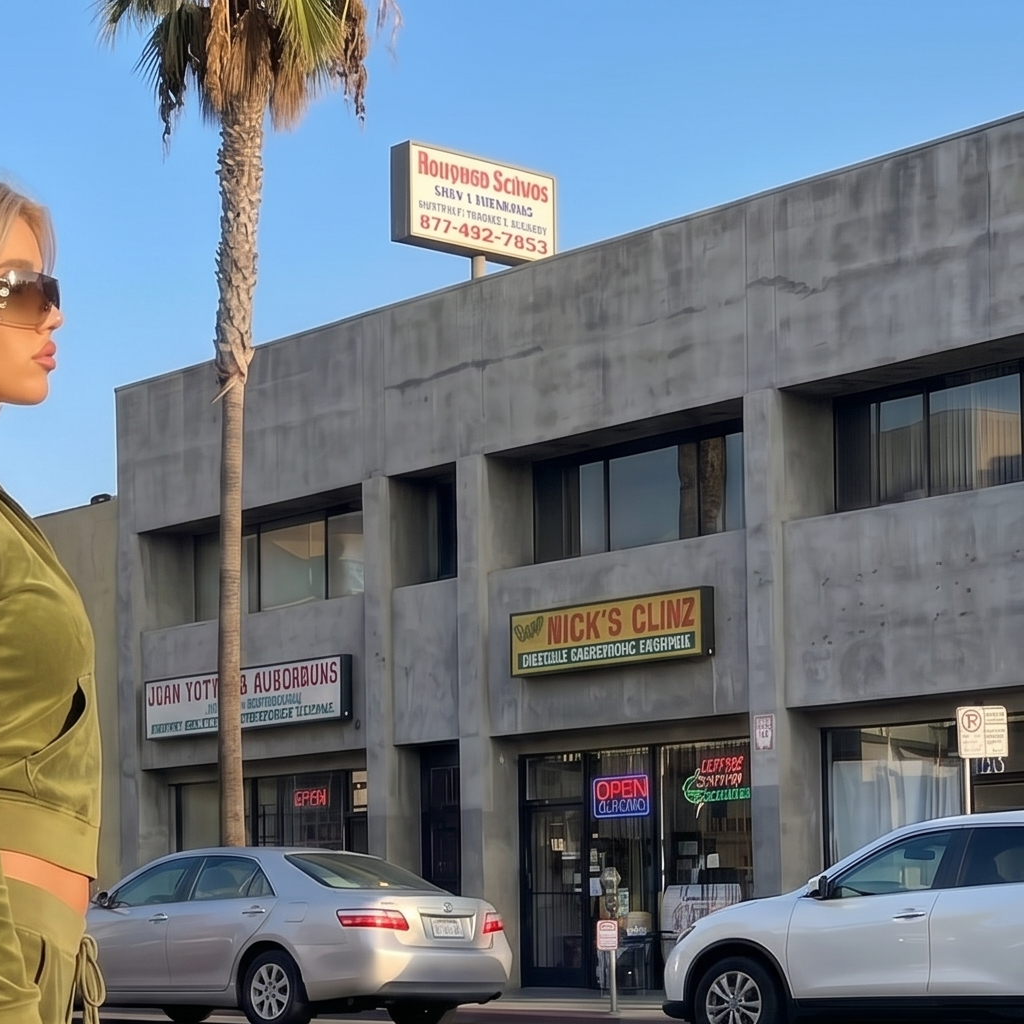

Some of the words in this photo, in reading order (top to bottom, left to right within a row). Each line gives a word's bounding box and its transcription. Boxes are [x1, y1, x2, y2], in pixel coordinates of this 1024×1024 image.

[547, 607, 622, 645] NICK'S
[631, 596, 695, 634] CLINZ
[596, 778, 647, 800] OPEN
